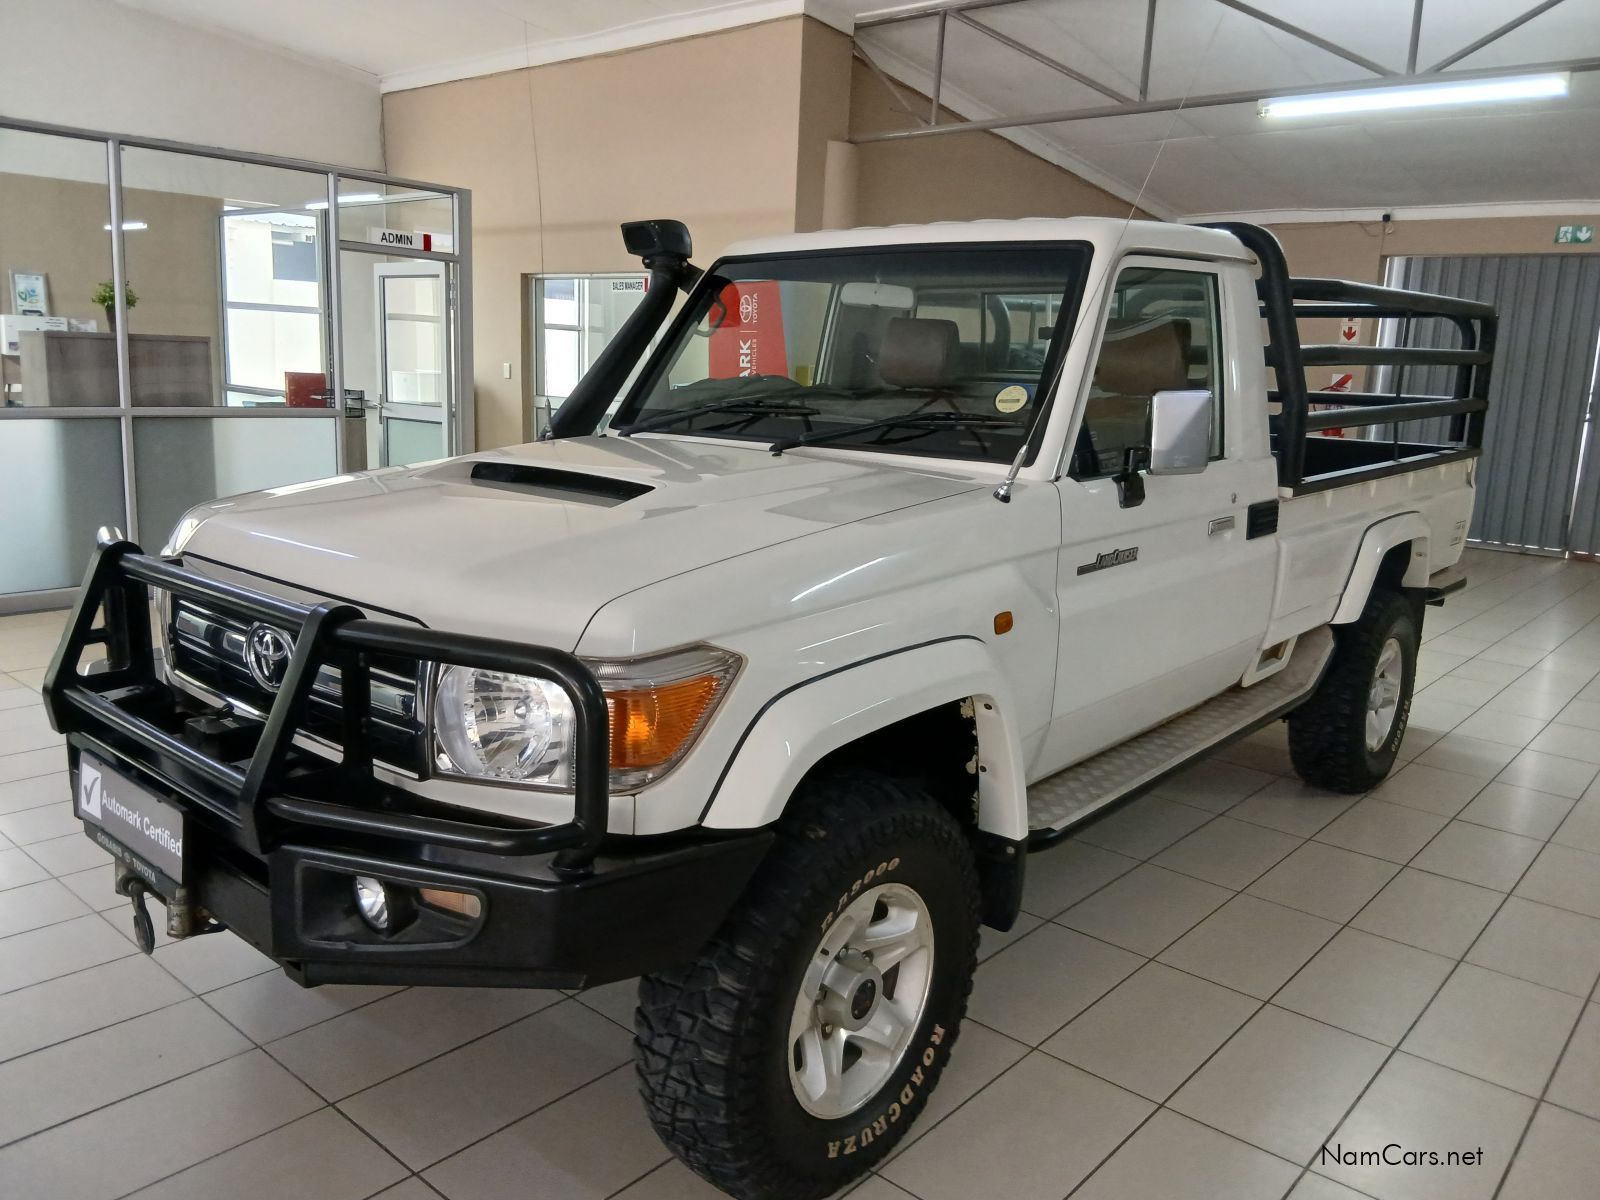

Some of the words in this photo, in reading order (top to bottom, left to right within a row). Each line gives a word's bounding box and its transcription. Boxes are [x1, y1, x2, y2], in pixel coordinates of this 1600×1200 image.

[380, 231, 413, 246] ADMIN
[102, 790, 142, 831] Automark
[143, 817, 183, 858] Certified
[132, 857, 156, 883] TOYOTA
[826, 1022, 946, 1160] ROADCRUZA
